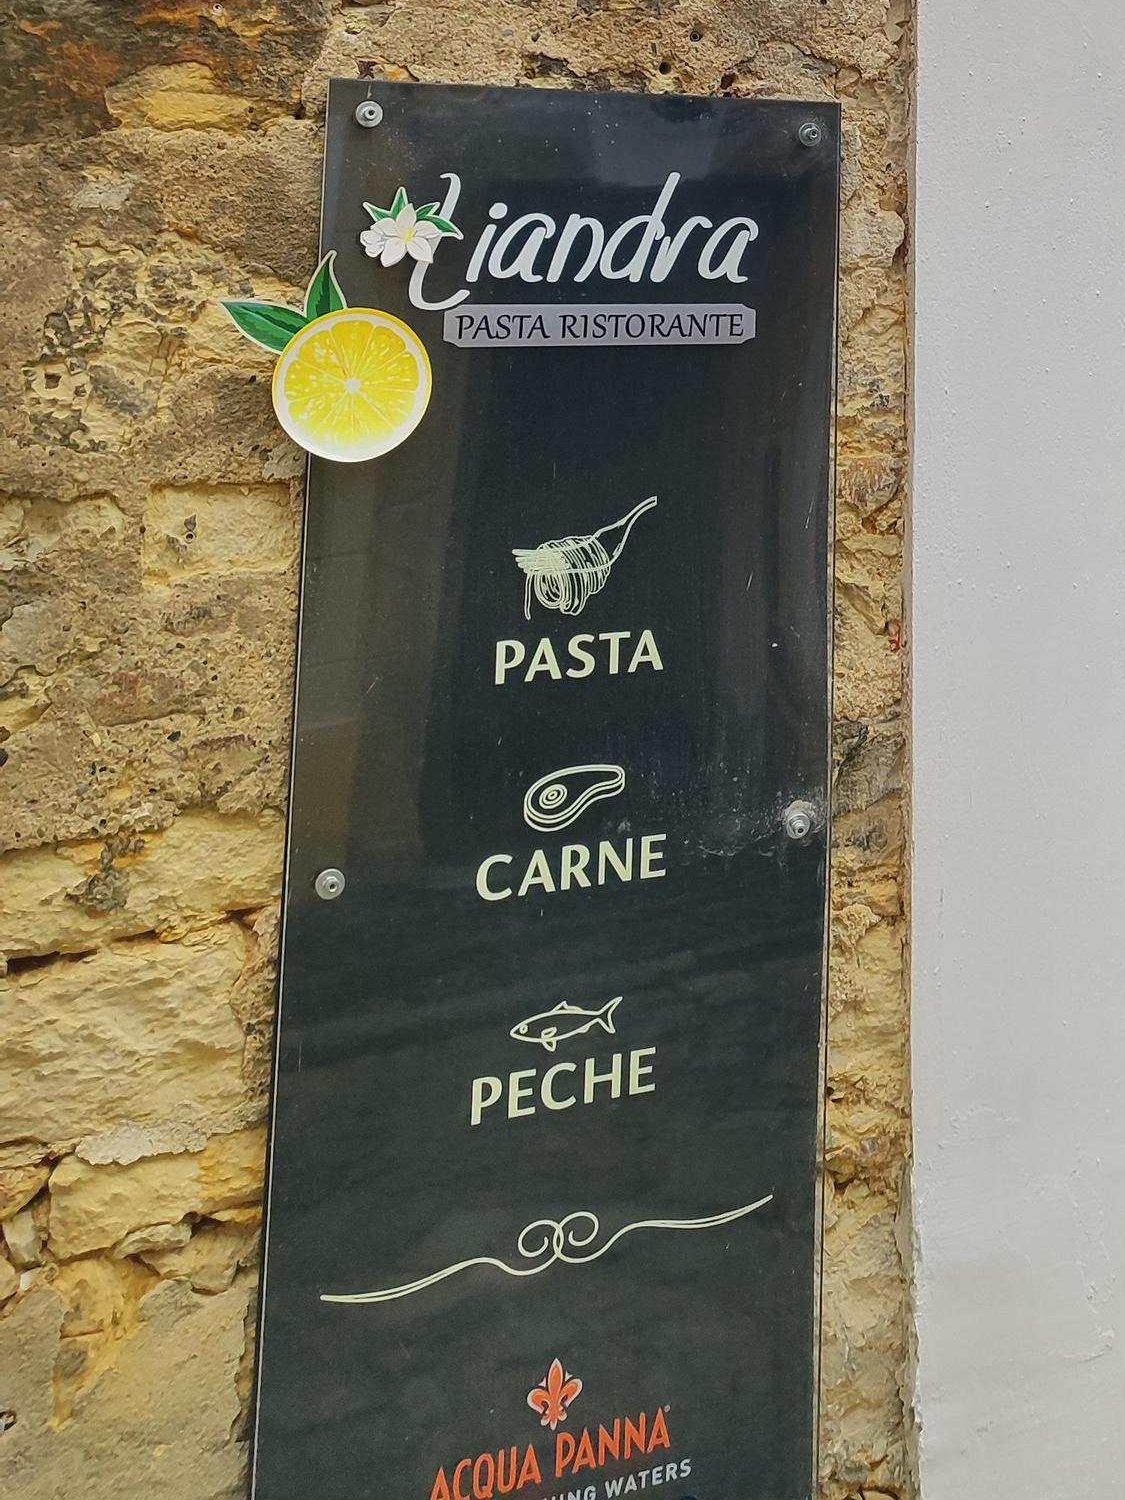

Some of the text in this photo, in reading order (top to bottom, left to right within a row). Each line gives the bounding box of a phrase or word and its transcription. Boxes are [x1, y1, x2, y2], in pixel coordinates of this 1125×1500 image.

[407, 171, 760, 311] Liandra
[455, 312, 745, 340] PASTA RISTORANTE
[494, 629, 665, 685] PASTA
[475, 833, 667, 901] CARNE
[470, 1046, 657, 1126] PECHE
[429, 1406, 672, 1500] ACQUA PANNA
[604, 1458, 693, 1499] WATERS
